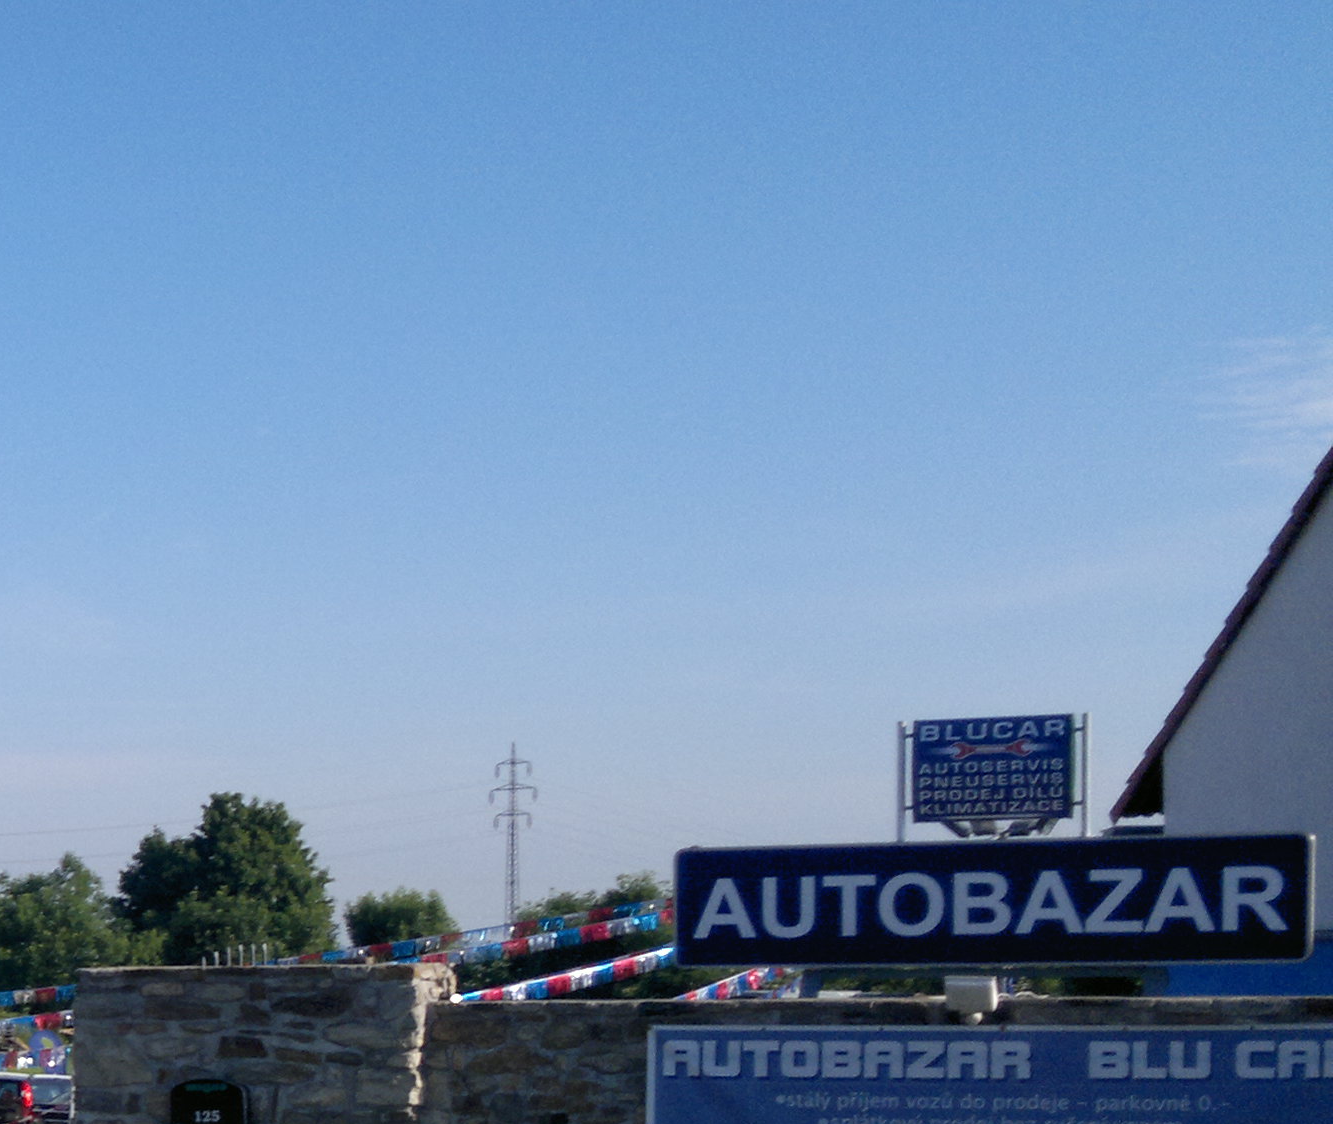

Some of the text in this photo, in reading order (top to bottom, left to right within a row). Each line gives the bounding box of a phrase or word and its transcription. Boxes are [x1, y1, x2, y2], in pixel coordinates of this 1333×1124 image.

[919, 719, 1065, 742] BLUCAR
[919, 757, 1064, 775] AUTOSERVIS
[919, 771, 1064, 788] PNEUSERVIS
[919, 788, 1006, 802] PRODEJ
[919, 800, 1064, 815] KLIMATIZACE
[693, 864, 1288, 940] AUTOBAZAR
[662, 1039, 1333, 1080] AUTOBAZAR BLU CA
[960, 1095, 985, 1109] do
[992, 1094, 1070, 1113] prodeje
[194, 1109, 221, 1123] 125
